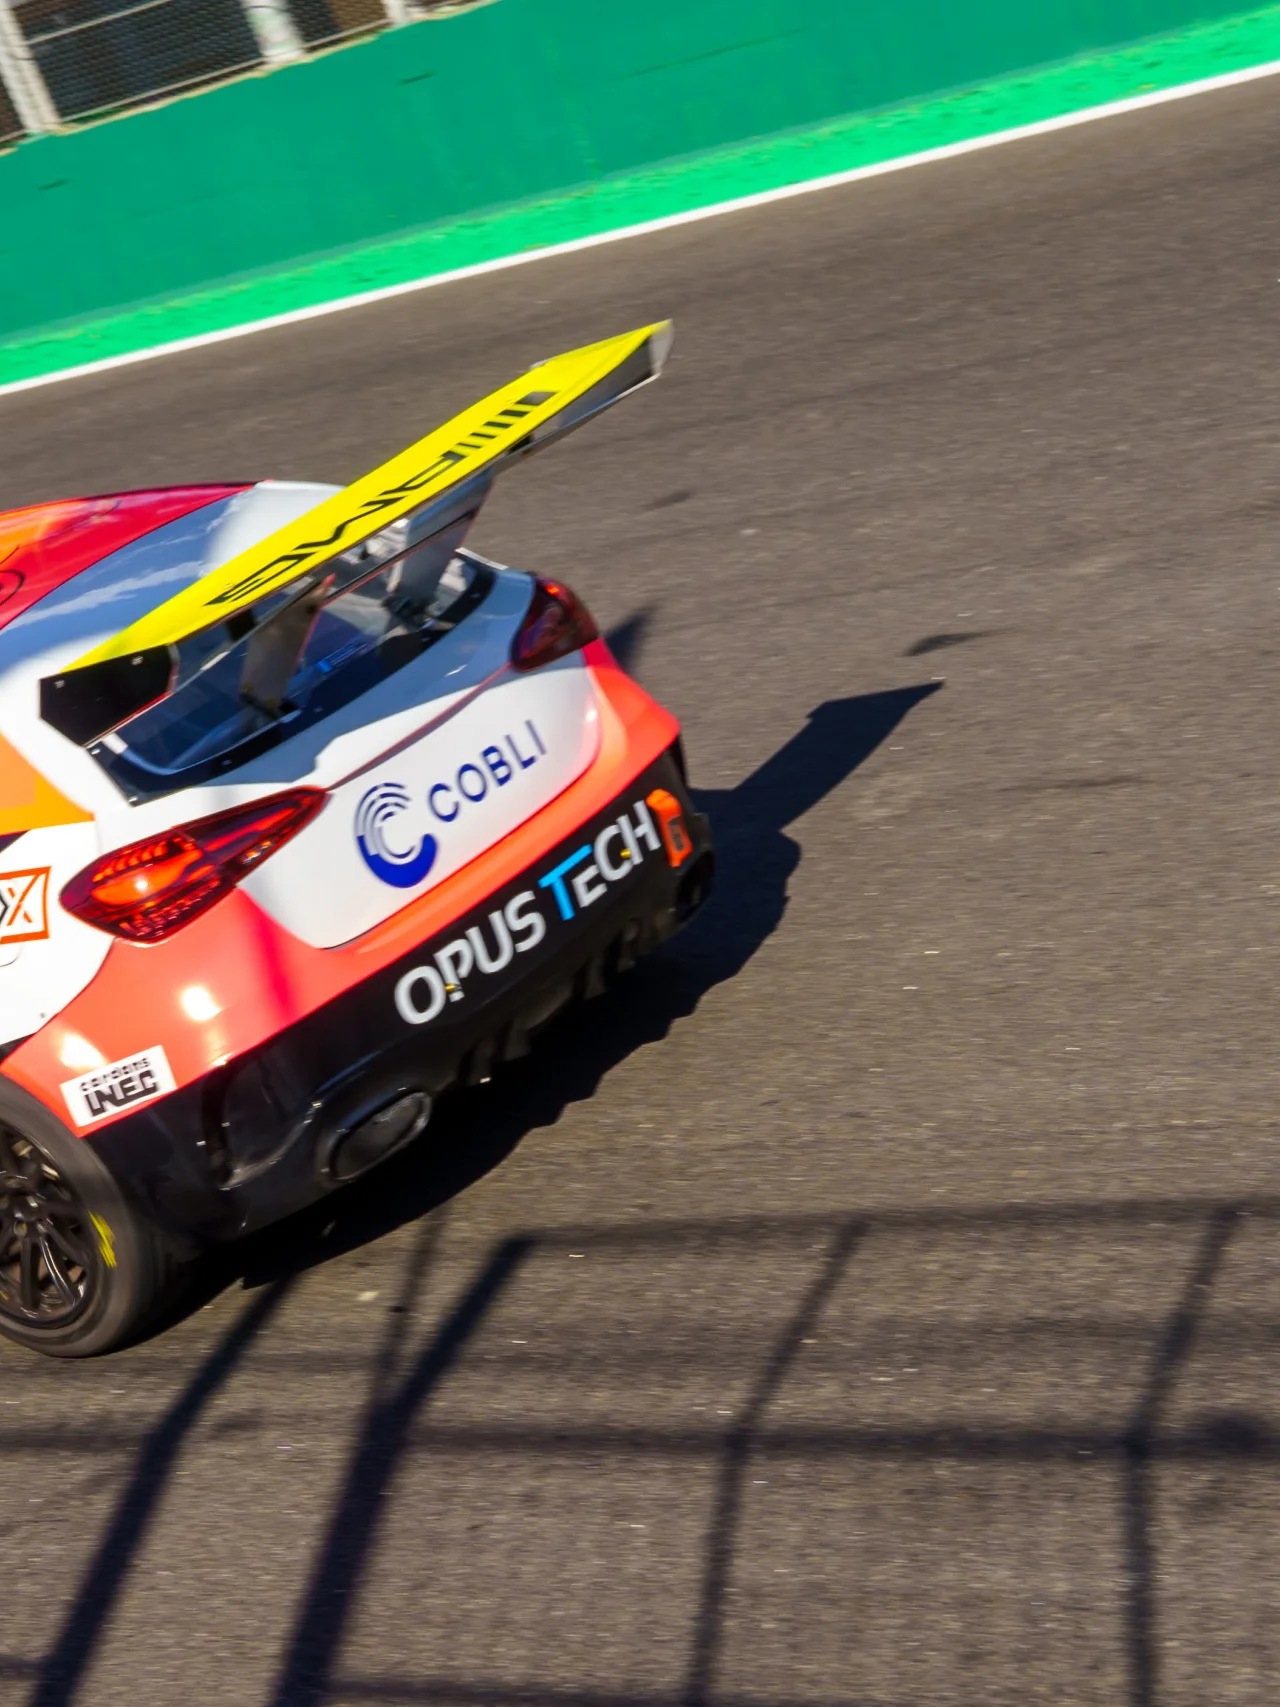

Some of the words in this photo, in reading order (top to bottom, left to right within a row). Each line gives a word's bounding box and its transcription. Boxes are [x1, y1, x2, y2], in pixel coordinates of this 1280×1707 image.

[428, 719, 548, 823] COBLI
[394, 890, 546, 1025] OPUS
[538, 800, 661, 920] TECH
[84, 1069, 159, 1117] INEC
